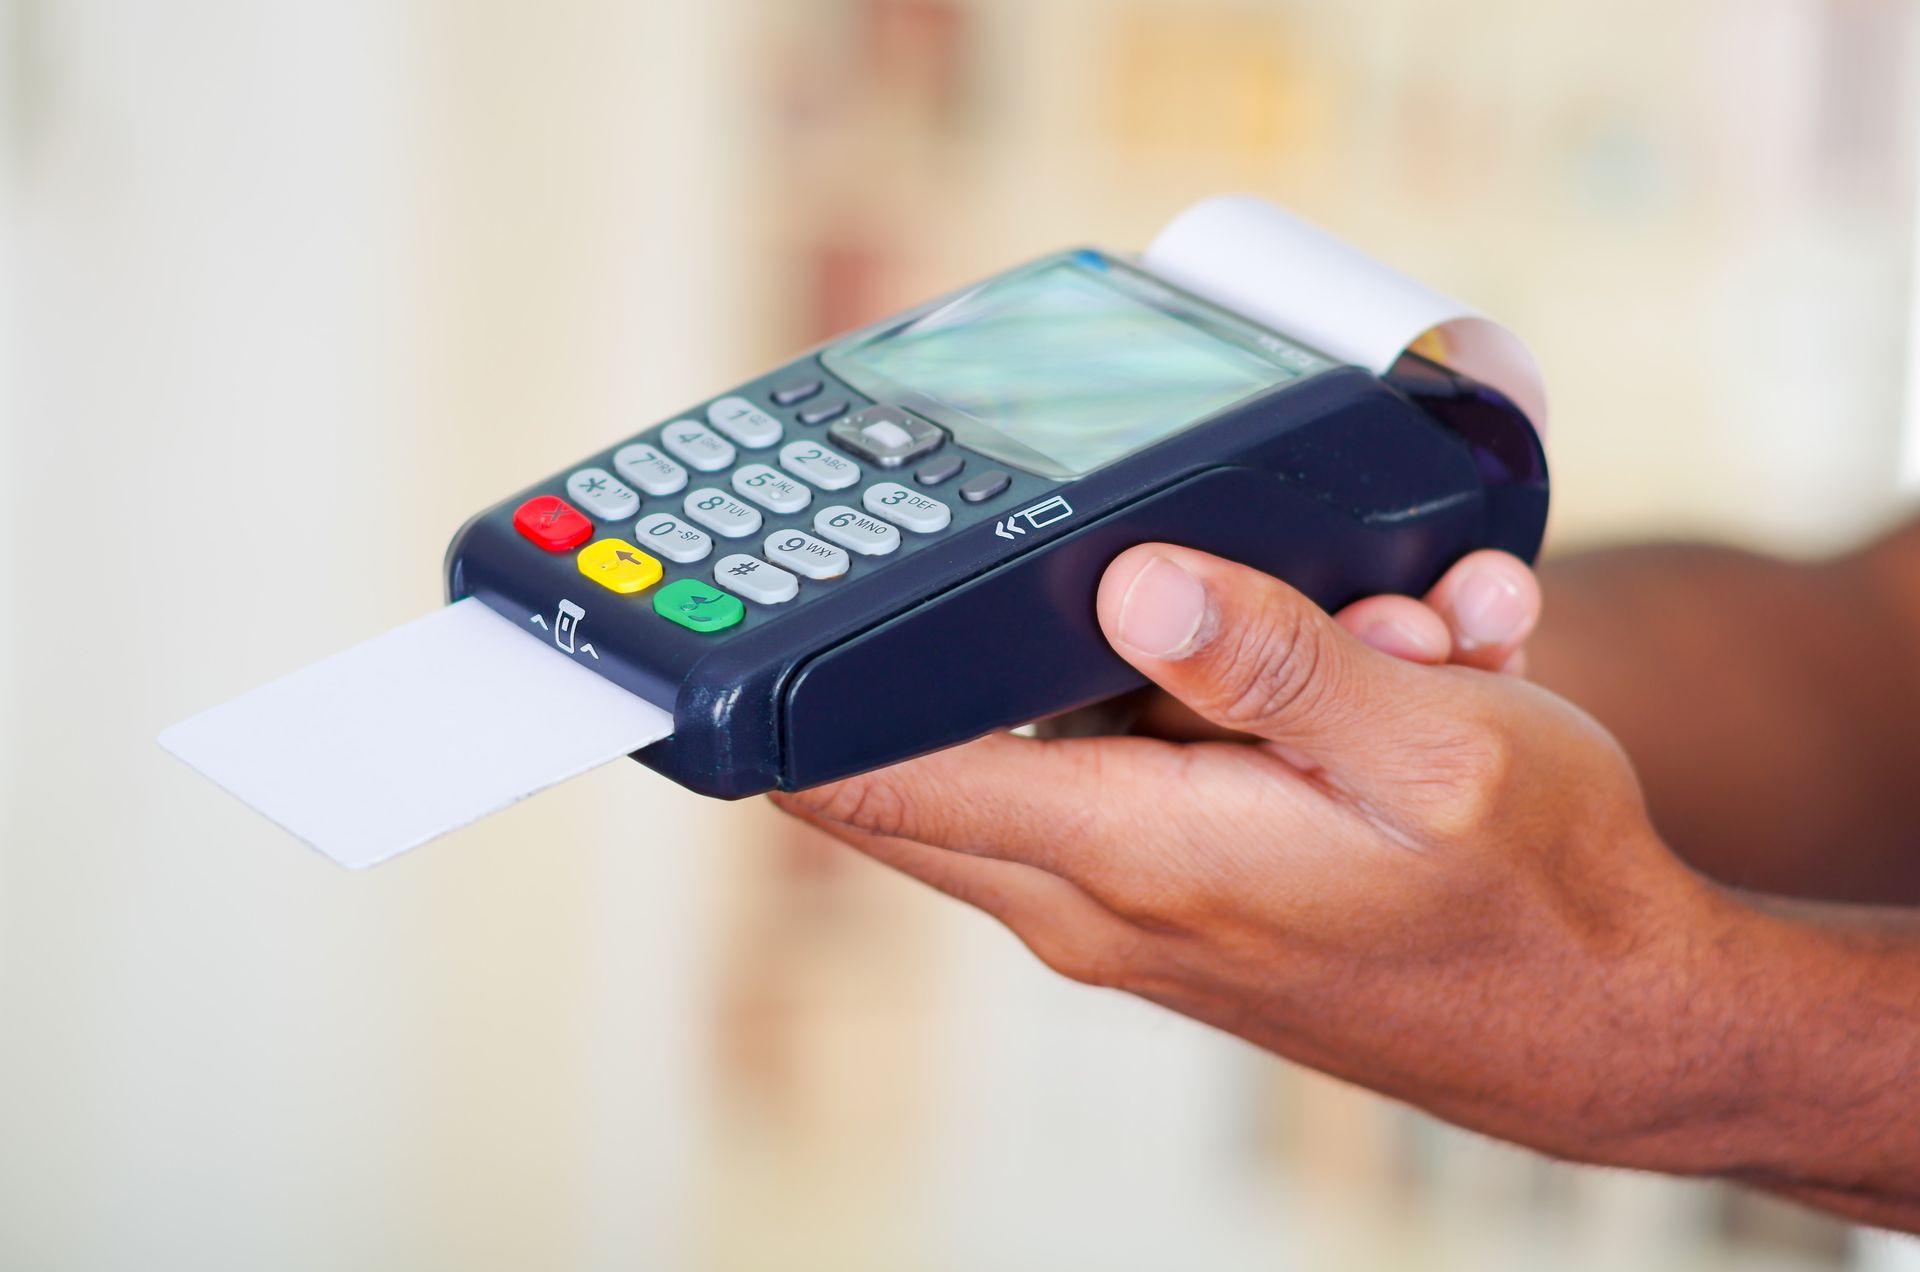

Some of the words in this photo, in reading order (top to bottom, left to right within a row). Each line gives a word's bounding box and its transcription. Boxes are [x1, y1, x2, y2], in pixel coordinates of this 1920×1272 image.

[629, 452, 655, 466] 7
[654, 457, 675, 476] PRS
[795, 450, 821, 464] 2
[820, 454, 848, 471] ABC
[746, 473, 774, 488] 5
[771, 480, 794, 495] JKL
[697, 496, 725, 511] 8
[721, 502, 751, 518] TUV
[881, 491, 908, 506] 3
[907, 496, 937, 512] DEF
[649, 521, 677, 537] 0
[828, 512, 856, 529] 6
[855, 518, 888, 535] MNO
[777, 537, 806, 553] 9
[805, 542, 837, 559] WXY
